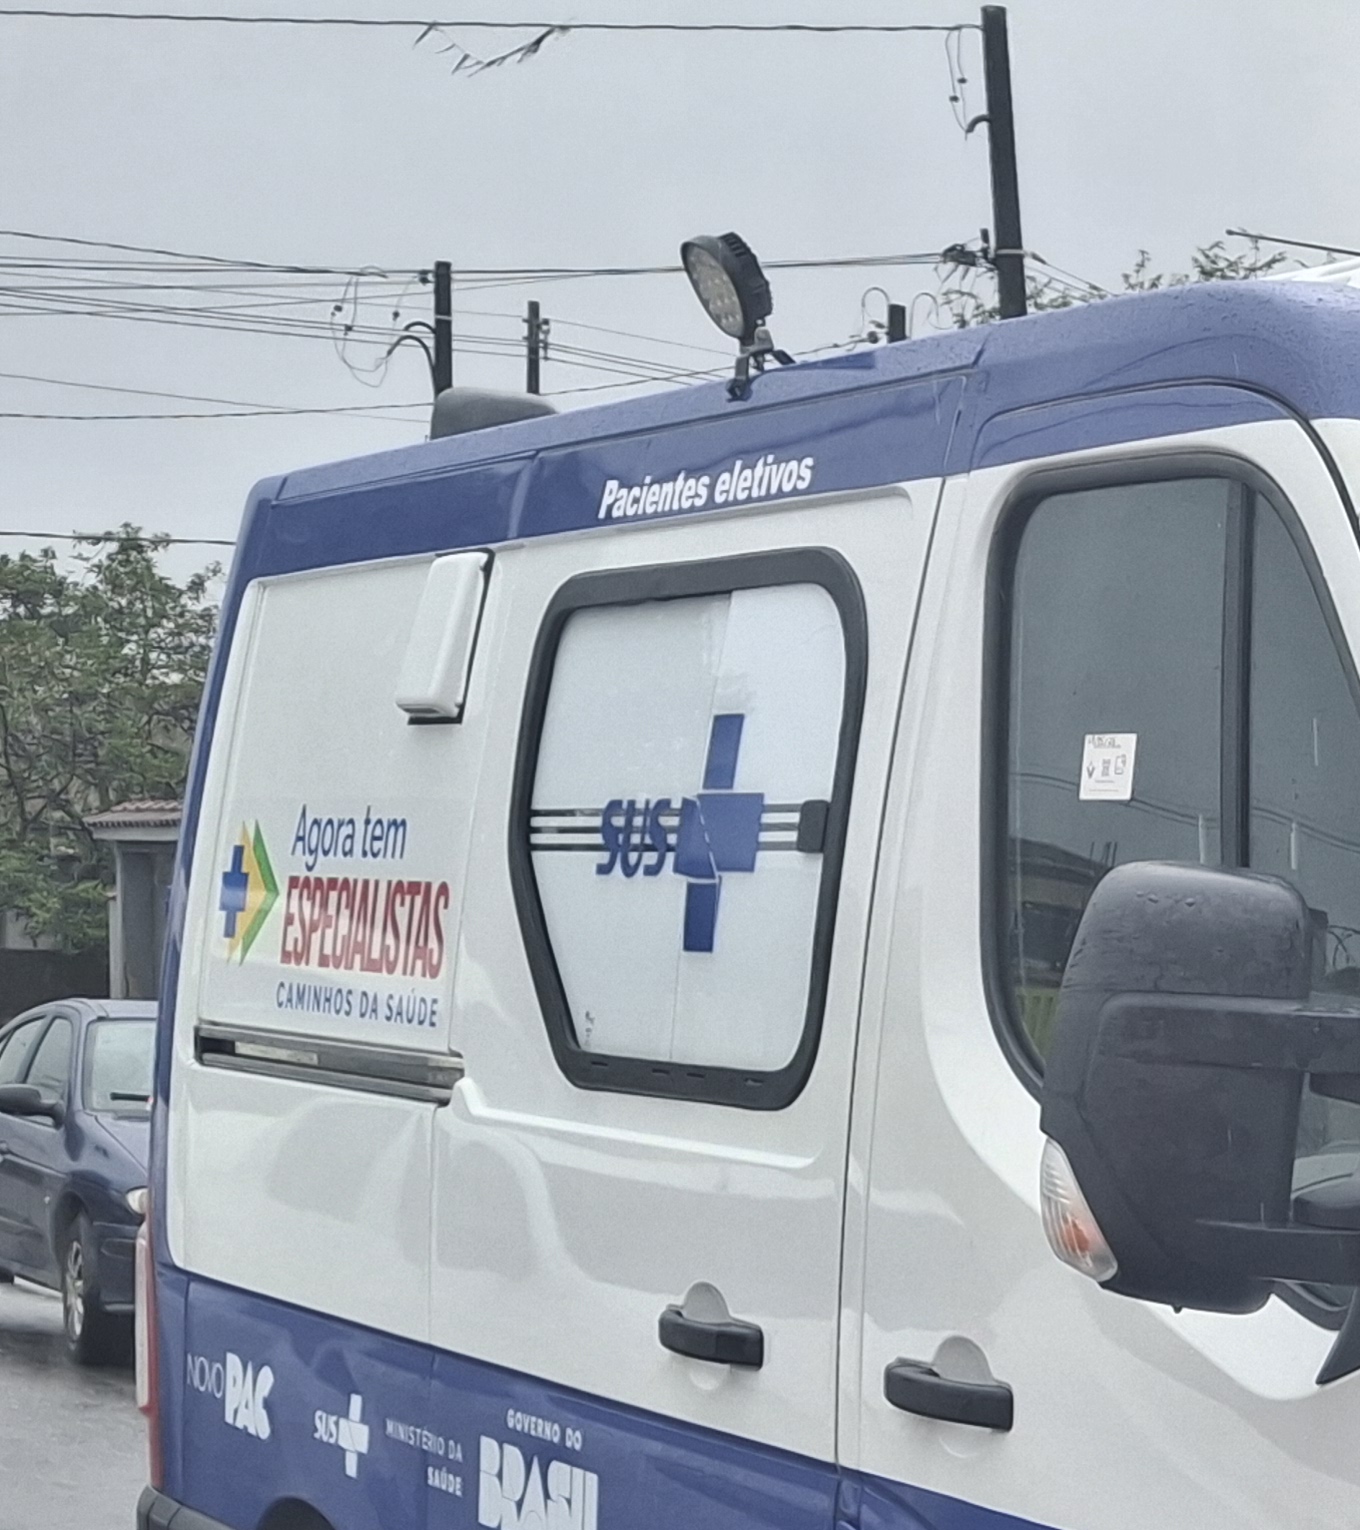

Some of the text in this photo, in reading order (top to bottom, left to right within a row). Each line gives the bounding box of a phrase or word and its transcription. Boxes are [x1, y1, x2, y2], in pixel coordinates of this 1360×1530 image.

[597, 454, 814, 520] Pacientes eletivos
[291, 804, 407, 872] Agora tem
[596, 798, 672, 878] SUS
[280, 875, 449, 979] ESPECIALISTAS
[276, 981, 439, 1028] CAMINHOS DA SAÚDE
[186, 1351, 274, 1440] NOVO PAC
[313, 1409, 338, 1444] SUS
[386, 1416, 464, 1463] MINISTÉRIO DA
[506, 1408, 583, 1451] GOVERNO DO
[427, 1466, 464, 1498] SAÚDE
